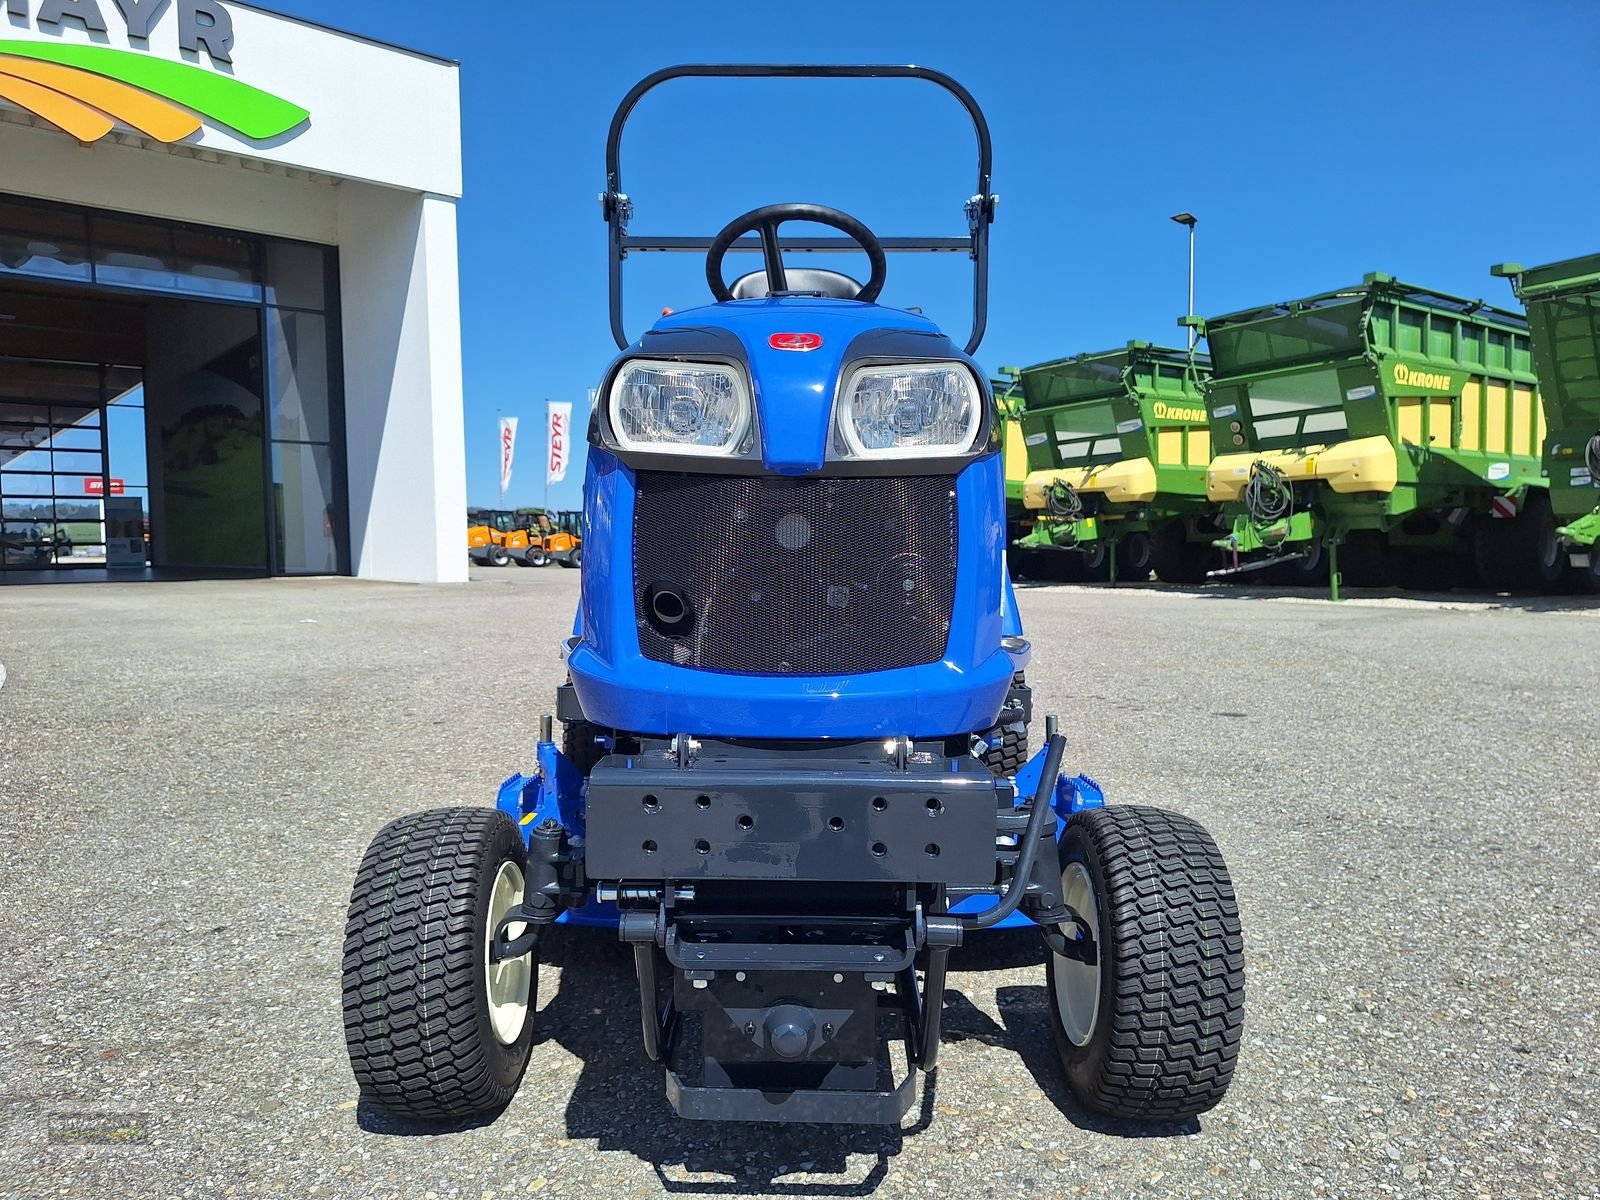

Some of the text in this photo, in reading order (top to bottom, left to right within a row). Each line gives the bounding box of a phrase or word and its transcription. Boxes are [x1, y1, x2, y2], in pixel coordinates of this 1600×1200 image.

[2, 0, 234, 64] AYR
[1408, 370, 1451, 391] KRONE
[1166, 407, 1208, 422] KRONE
[551, 413, 563, 473] STEYR
